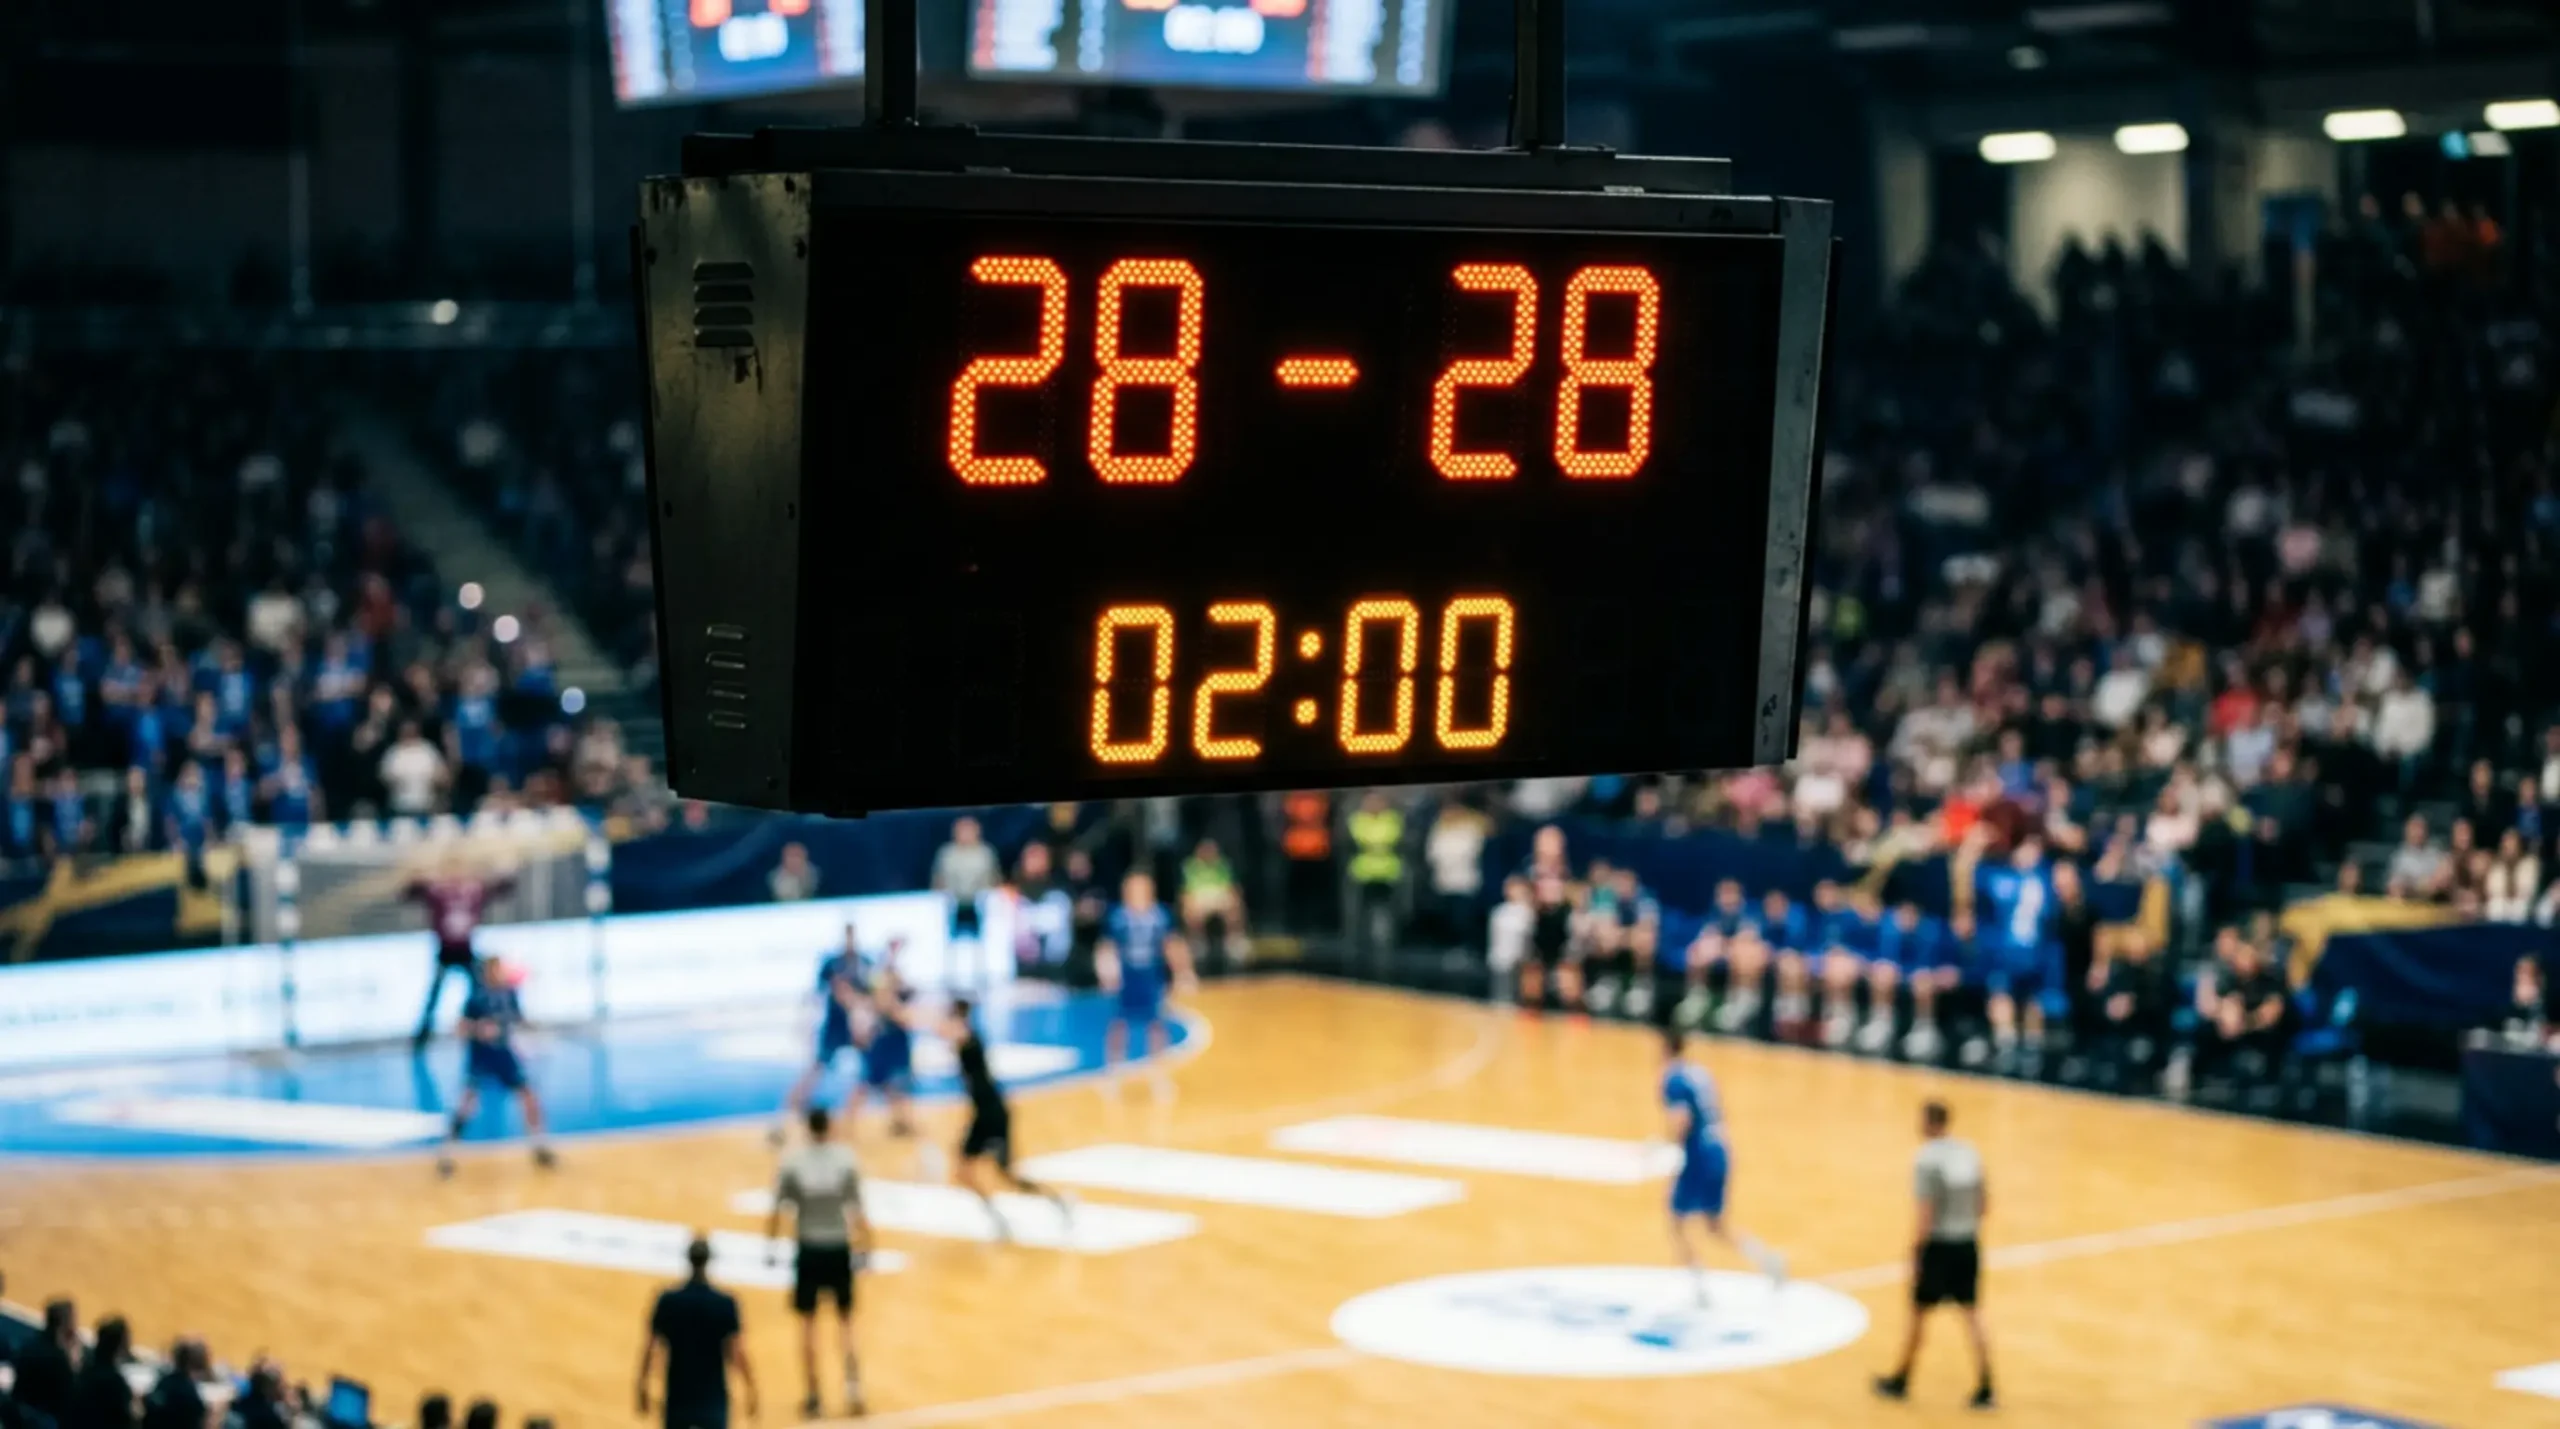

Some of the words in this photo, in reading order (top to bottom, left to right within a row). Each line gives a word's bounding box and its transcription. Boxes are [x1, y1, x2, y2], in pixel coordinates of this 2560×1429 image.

[948, 257, 1203, 485] 28
[1430, 264, 1659, 479] 28
[1091, 596, 1514, 763] 02:00
